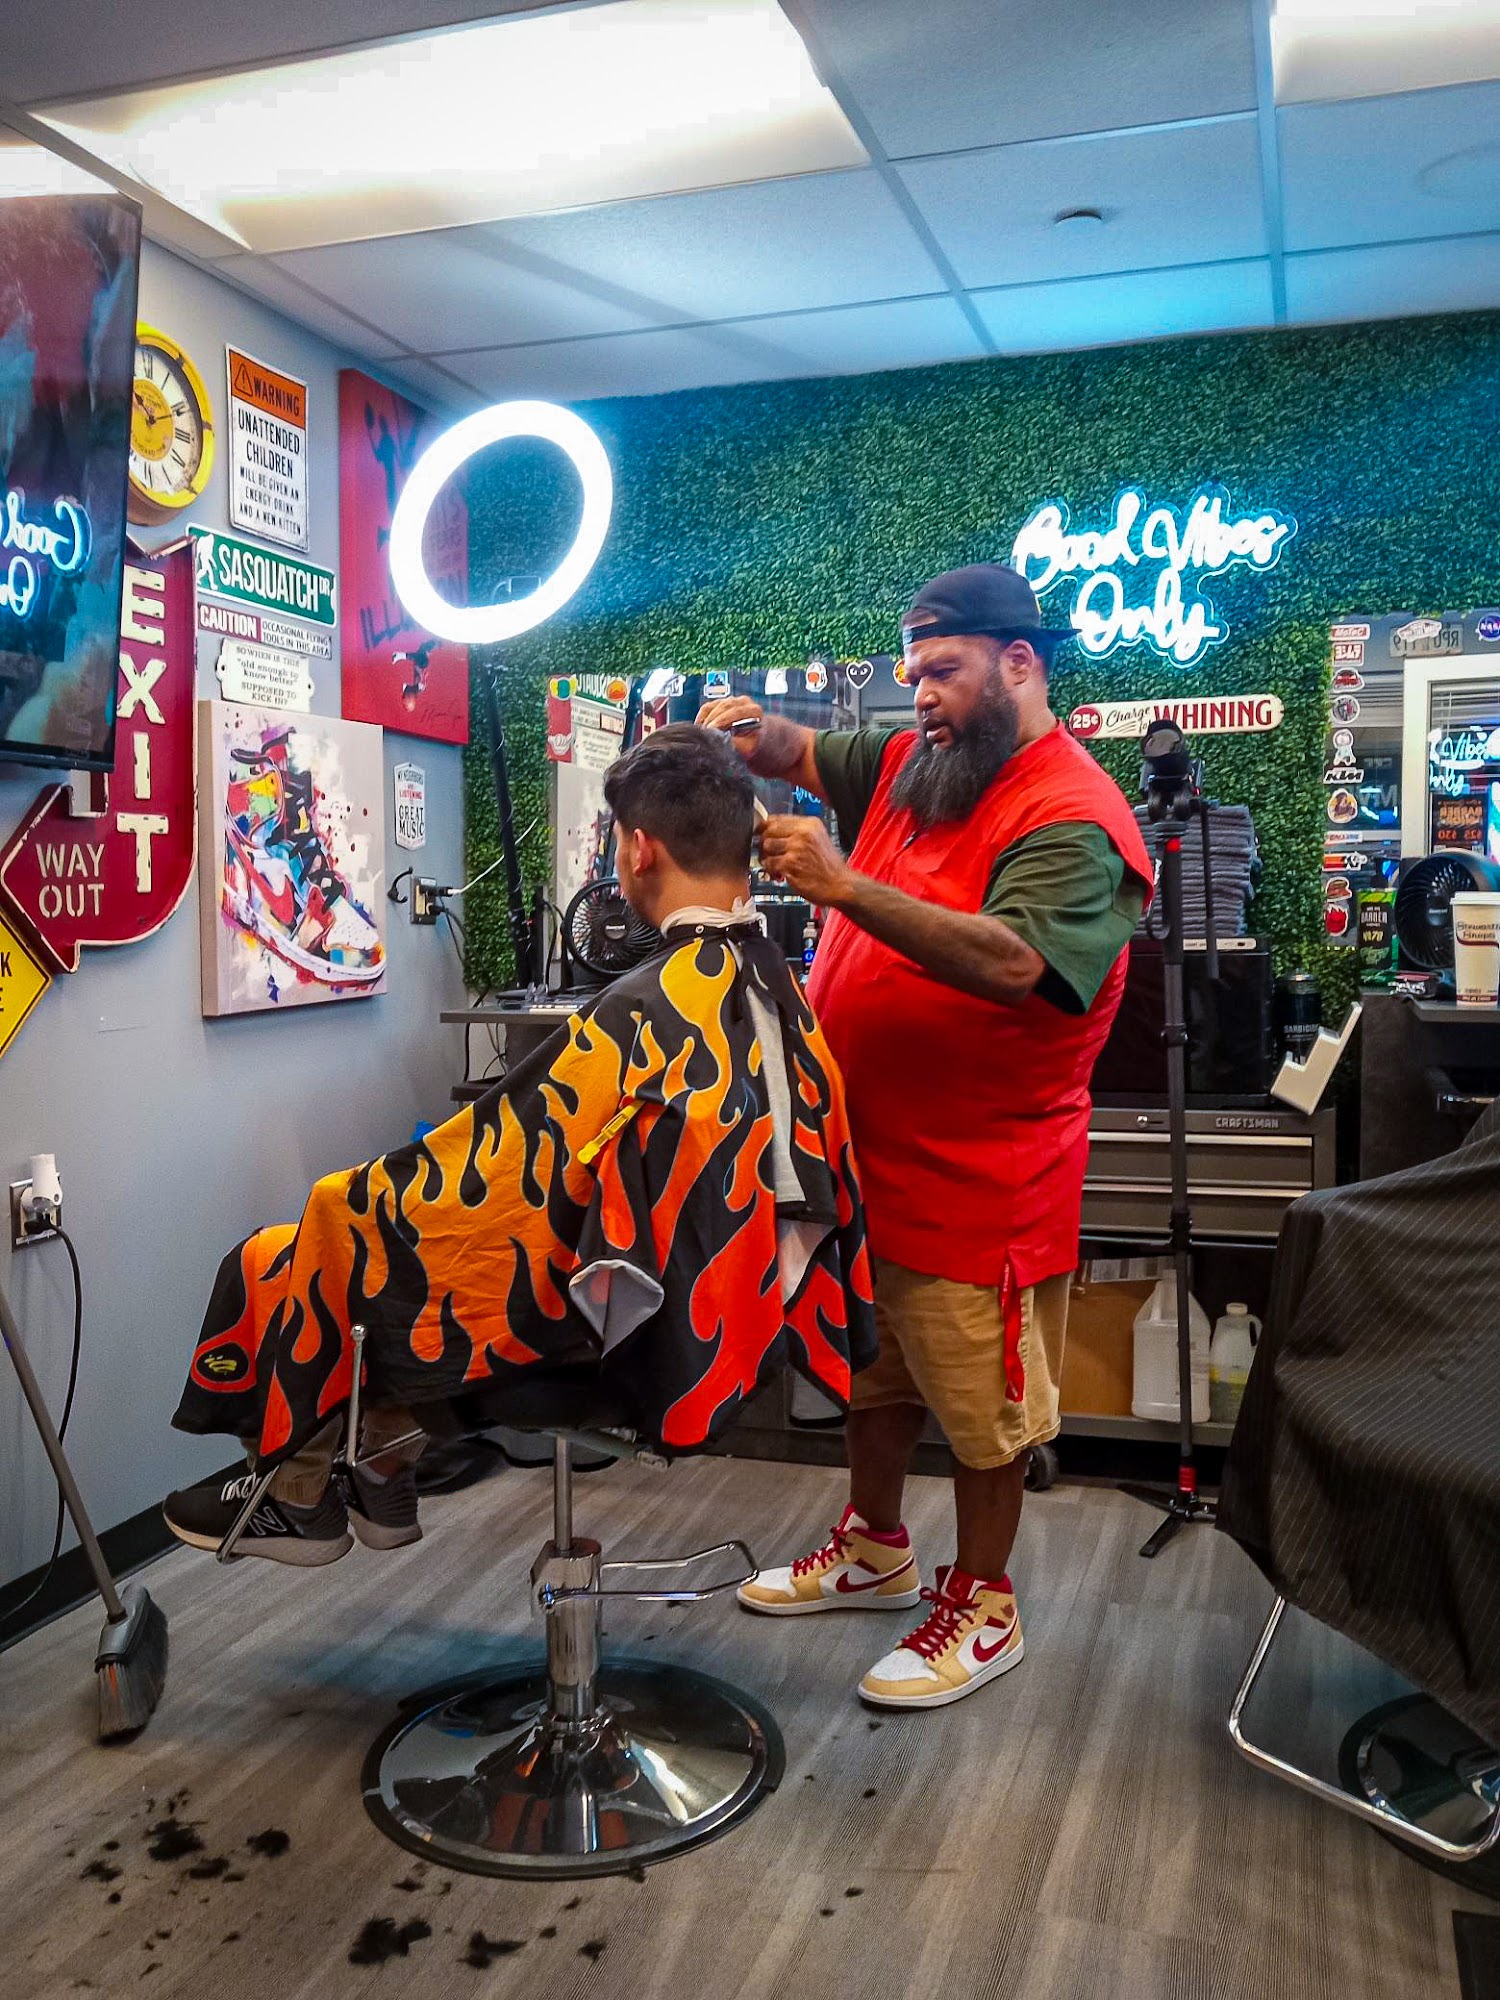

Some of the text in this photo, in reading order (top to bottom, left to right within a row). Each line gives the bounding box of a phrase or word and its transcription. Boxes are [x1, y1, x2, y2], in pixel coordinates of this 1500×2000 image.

[253, 376, 300, 417] WARNING
[238, 408, 300, 455] UNATTENDED
[246, 440, 293, 479] CHILDREN
[240, 465, 299, 501] WILL BE GIVEN AN
[245, 486, 294, 516] ENERGY DRINK
[239, 502, 301, 536] AND A NEW KITTEN
[218, 543, 331, 613] SASQUATCH DR
[199, 604, 257, 639] CAUTION
[1070, 567, 1221, 661] Only
[1480, 622, 1500, 635] NAS
[262, 620, 328, 646] OCCASIONAL FLYING
[262, 631, 330, 657] TOOLS IN THIS AREA
[236, 646, 246, 655] SO
[247, 648, 271, 660] WHEN
[241, 681, 297, 699] SUPPOSED TO
[252, 692, 272, 703] KICK
[116, 564, 169, 893] EXIT
[1072, 713, 1099, 729] 25¢
[1106, 706, 1151, 728] Charge
[1153, 699, 1272, 730] WHINING
[398, 804, 424, 821] GREAT
[399, 820, 425, 839] MUSIC
[35, 843, 105, 878] WAY
[38, 883, 105, 919] OUT
[1215, 1117, 1279, 1129] CRAFTSMAN
